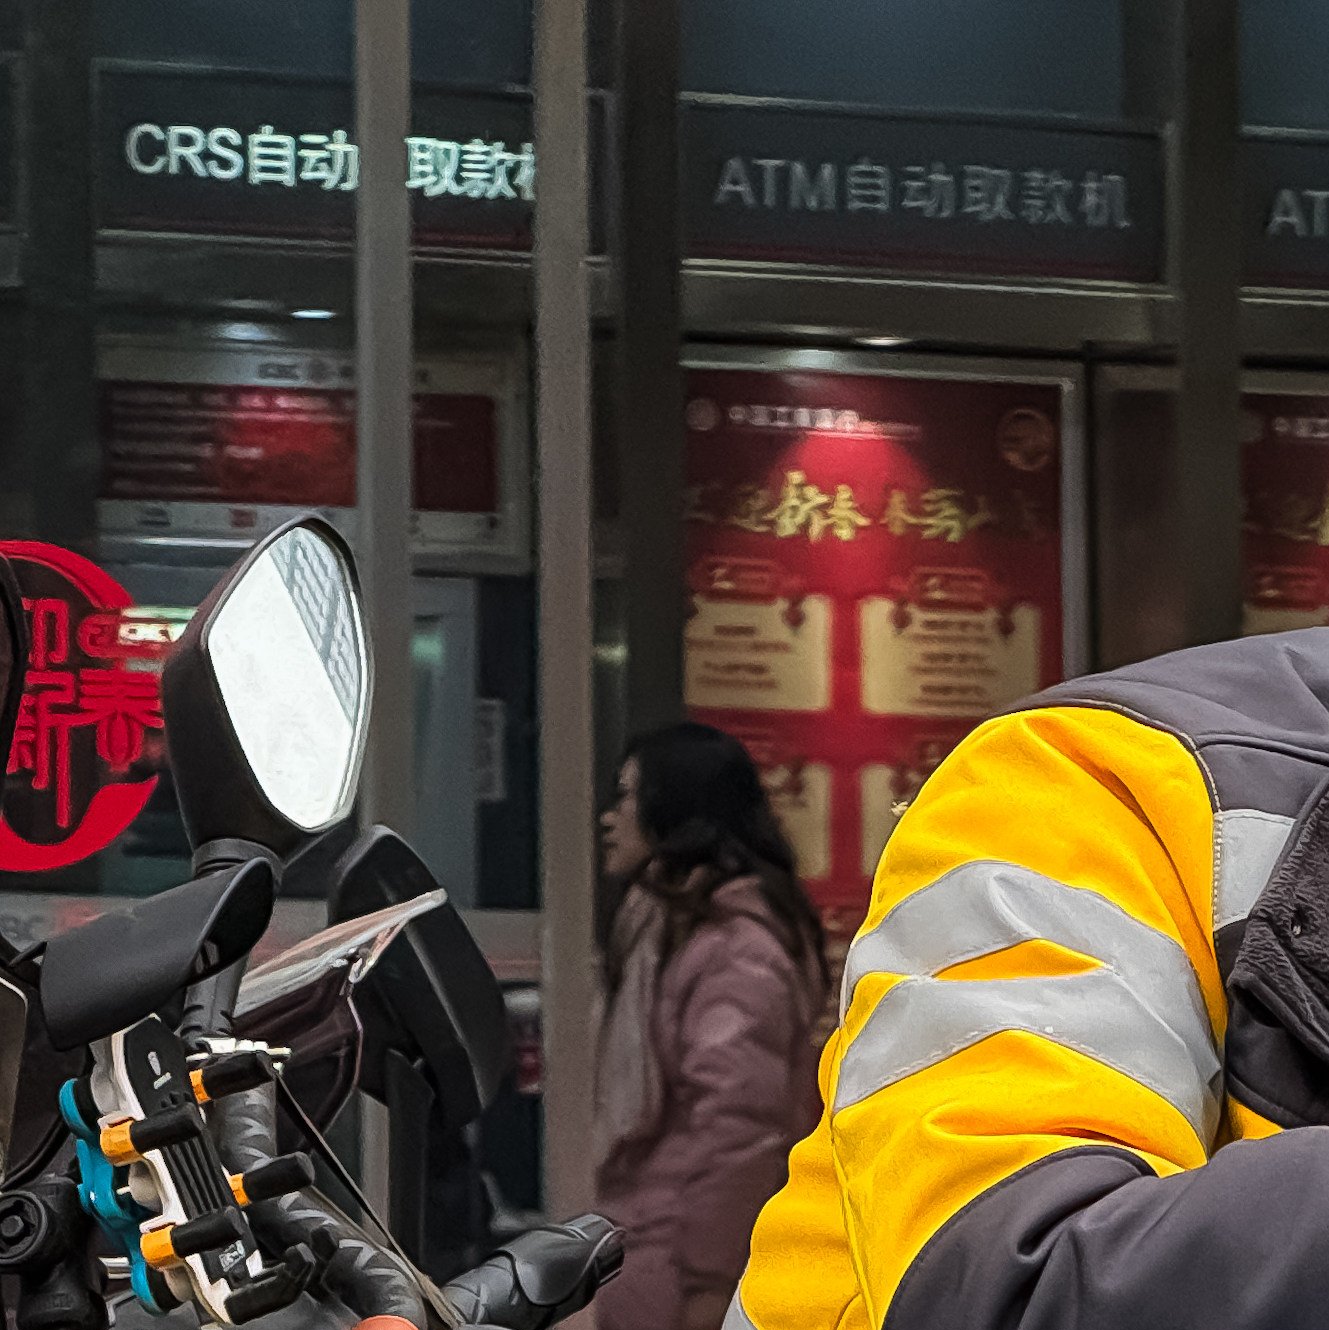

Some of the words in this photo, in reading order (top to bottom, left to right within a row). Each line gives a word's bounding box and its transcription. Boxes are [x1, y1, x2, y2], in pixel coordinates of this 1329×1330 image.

[713, 156, 1131, 228] ATM自动取款机
